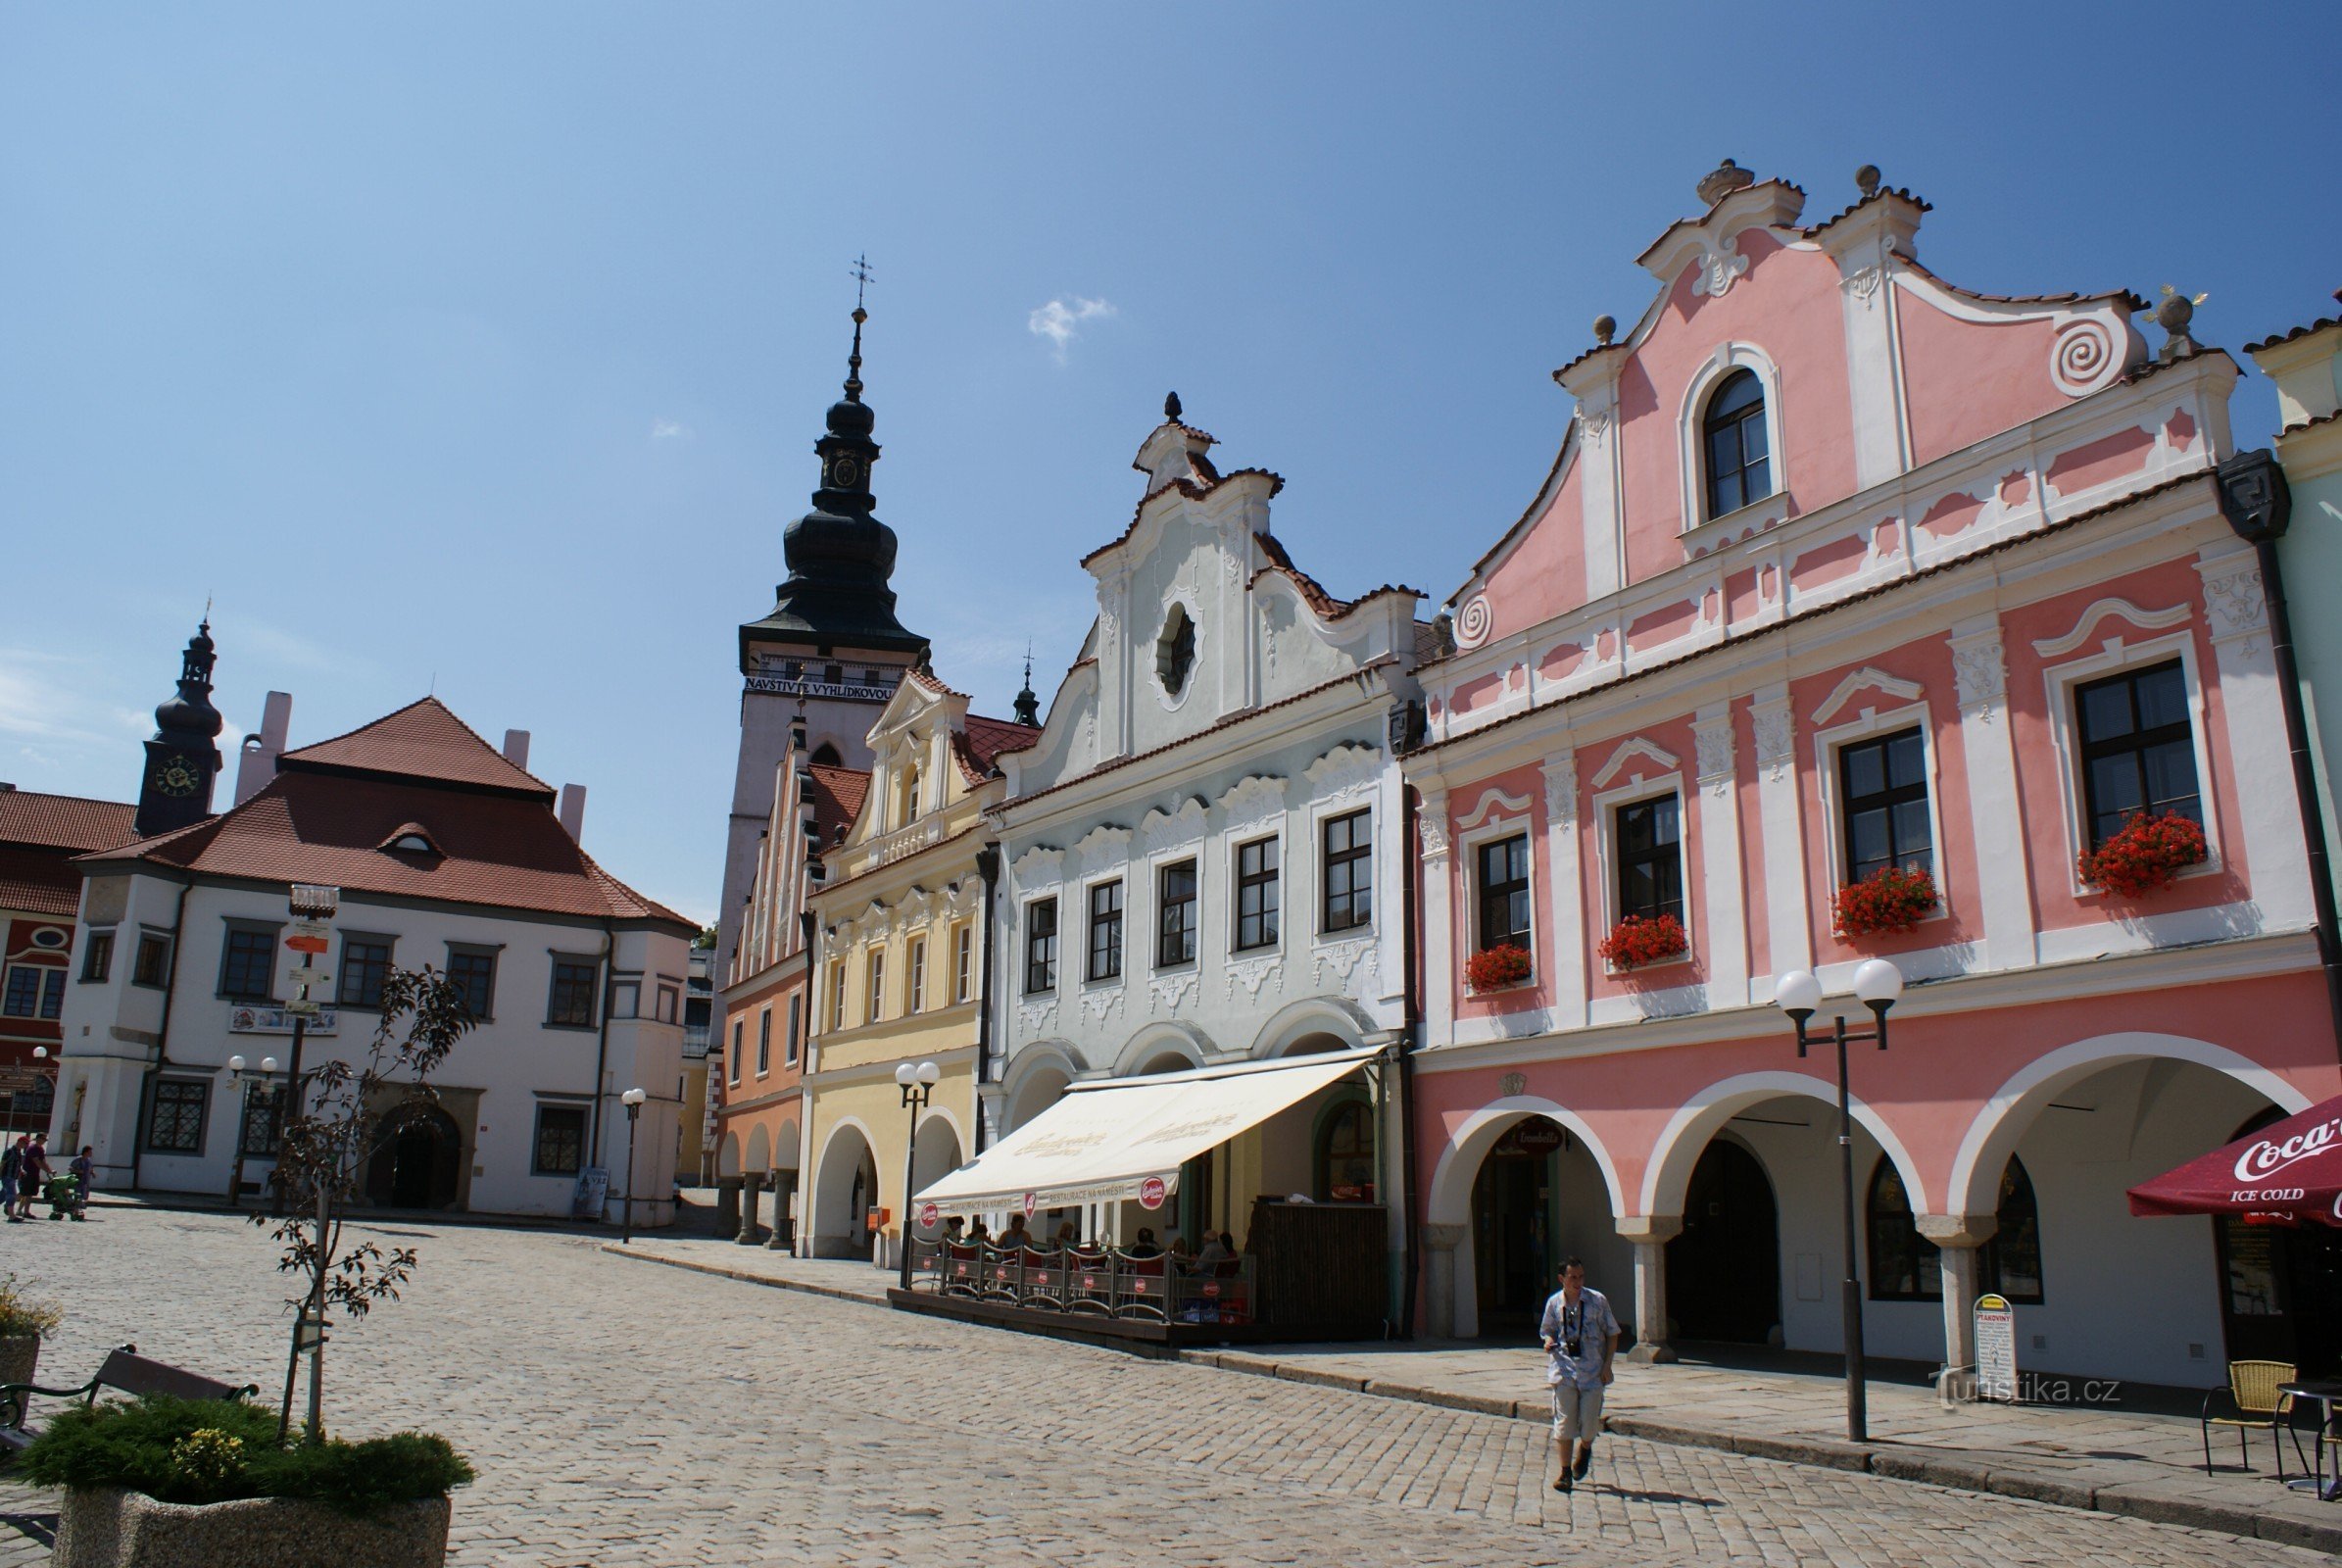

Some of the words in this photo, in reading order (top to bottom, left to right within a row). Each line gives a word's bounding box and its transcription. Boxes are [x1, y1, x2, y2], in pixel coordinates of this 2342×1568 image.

[2233, 1118, 2342, 1182] Coca-
[2230, 1190, 2257, 1202] ICE
[2261, 1188, 2304, 1201] COLD
